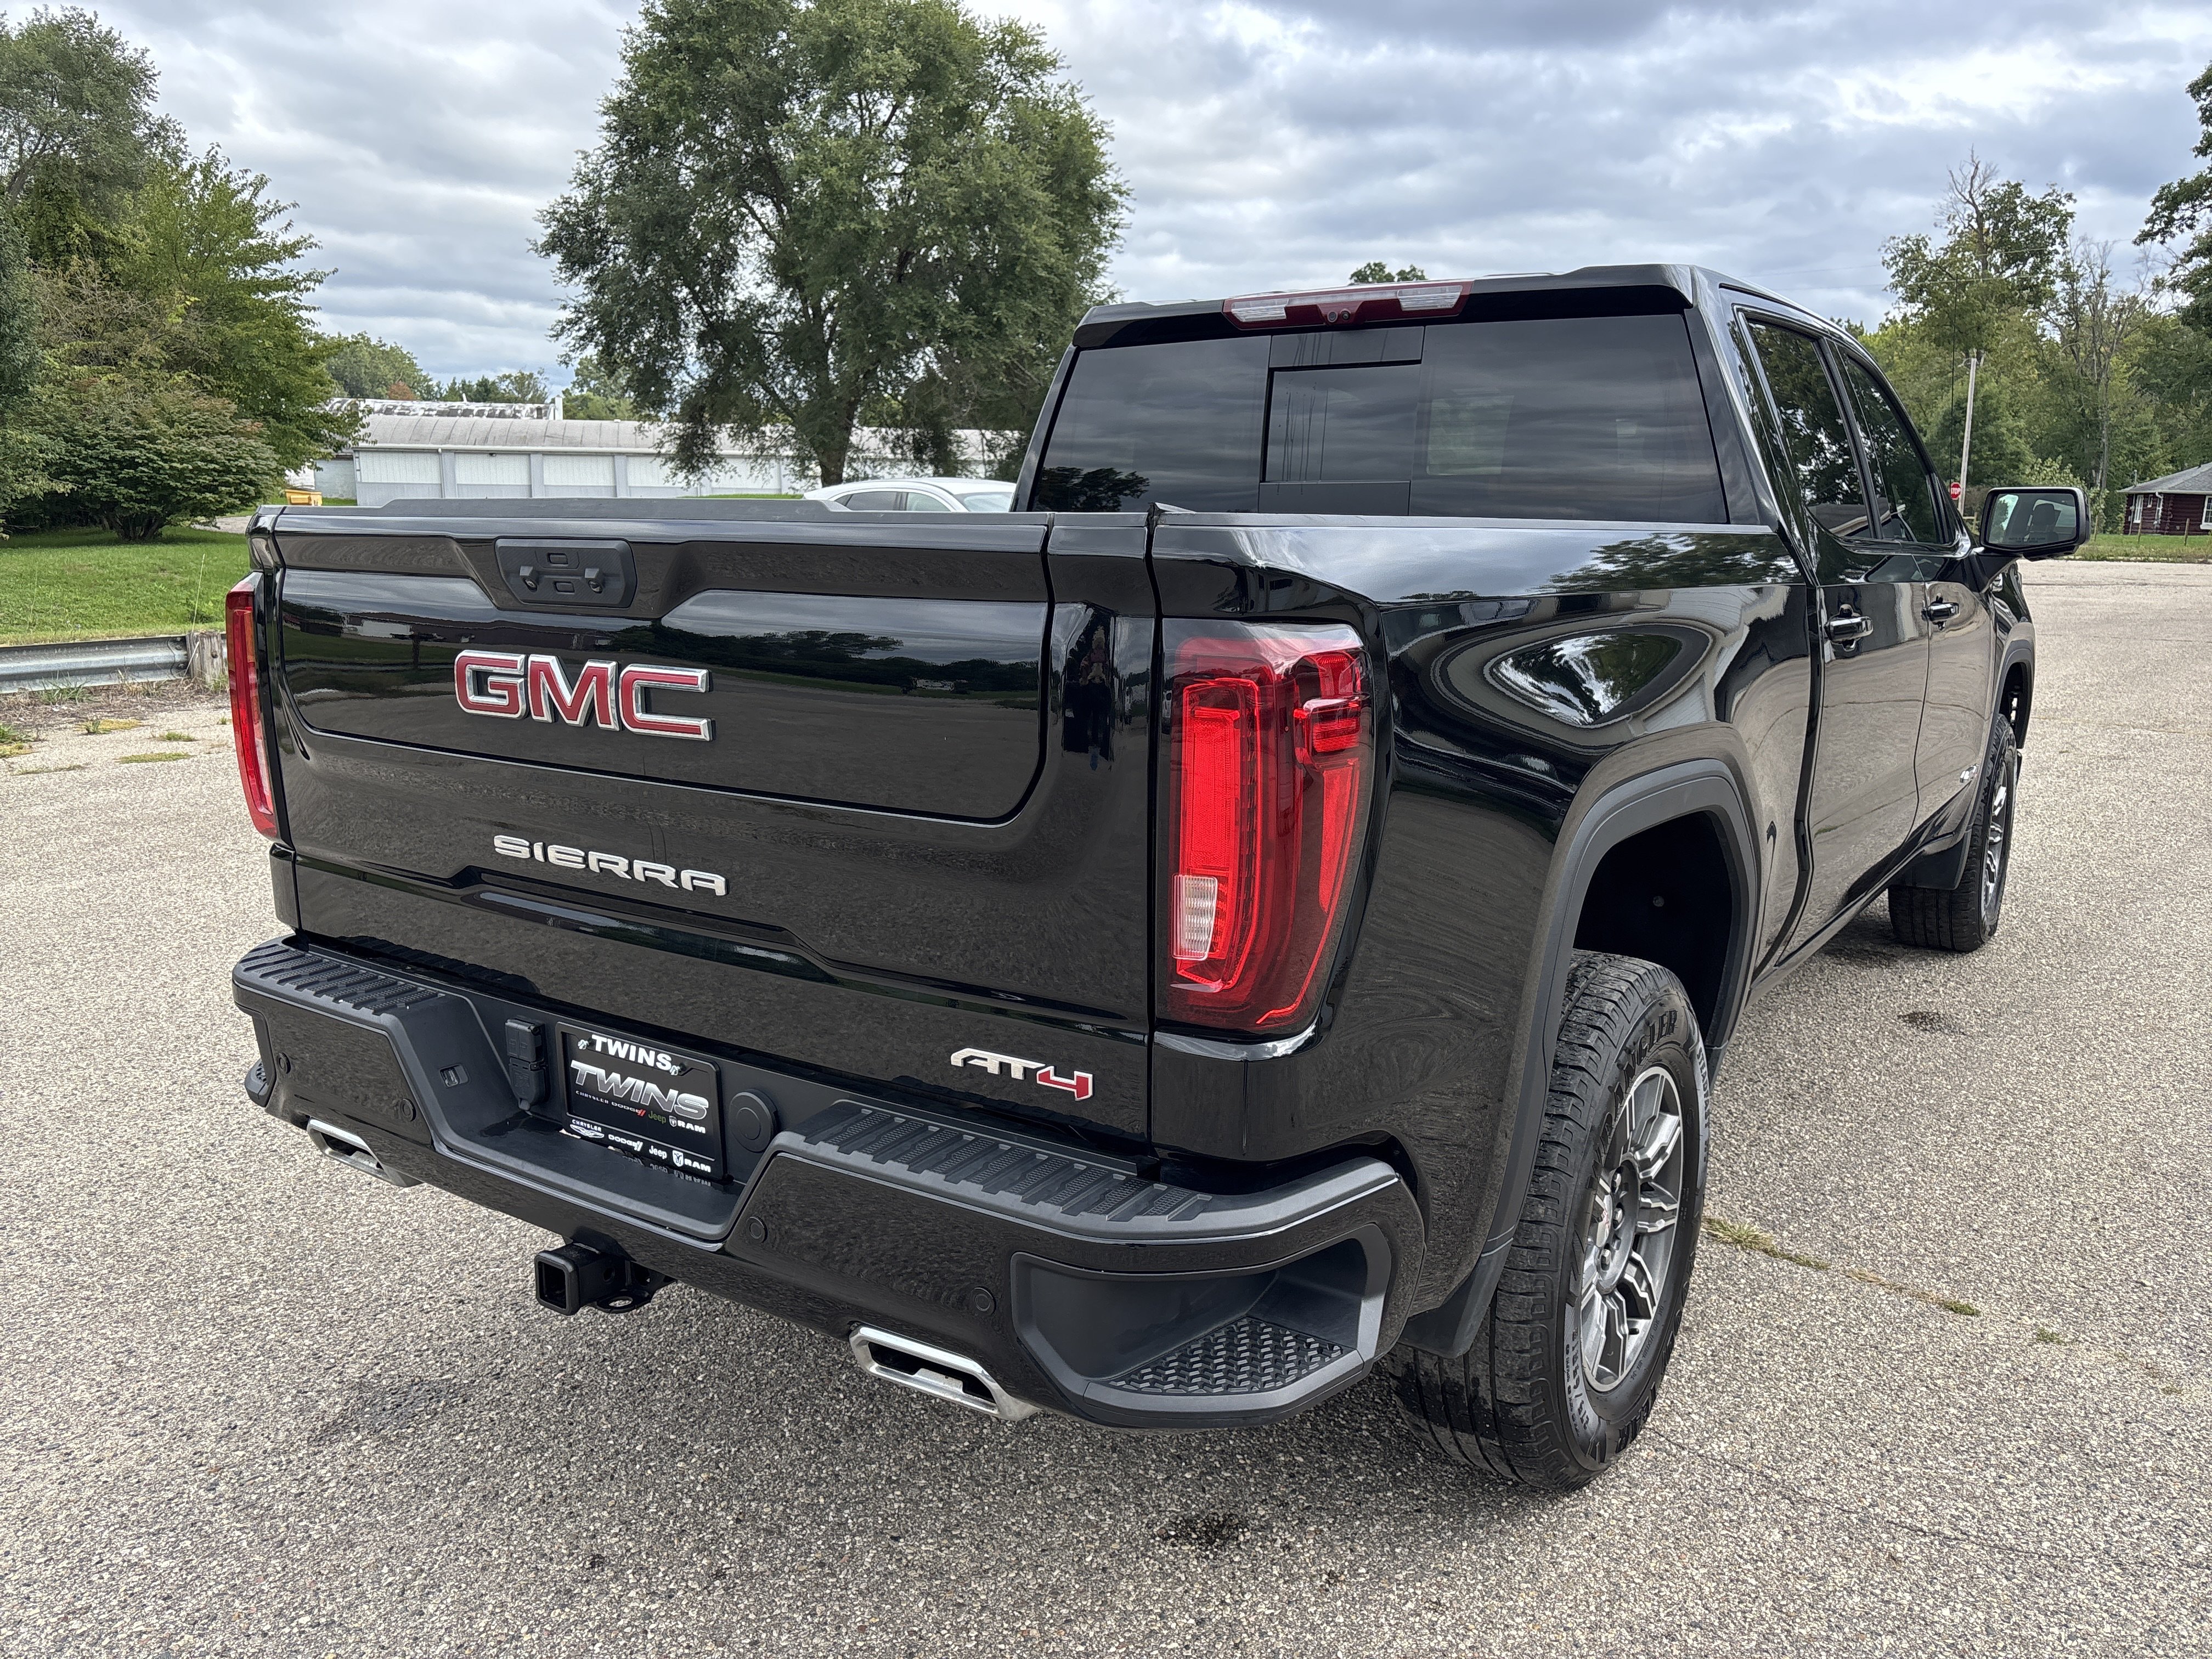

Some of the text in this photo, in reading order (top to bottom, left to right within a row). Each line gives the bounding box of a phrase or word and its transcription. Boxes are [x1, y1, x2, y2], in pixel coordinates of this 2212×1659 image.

[454, 650, 713, 742] GMC
[494, 834, 728, 896] SIERRA
[591, 1034, 672, 1071] TWINS
[950, 1047, 1093, 1102] AT4
[570, 1059, 709, 1120] TWINS
[575, 1090, 706, 1133] CHRYSLER DODGE Jeep RAM
[572, 1119, 711, 1173] CHRYSLER DODGE Jeep RAM
